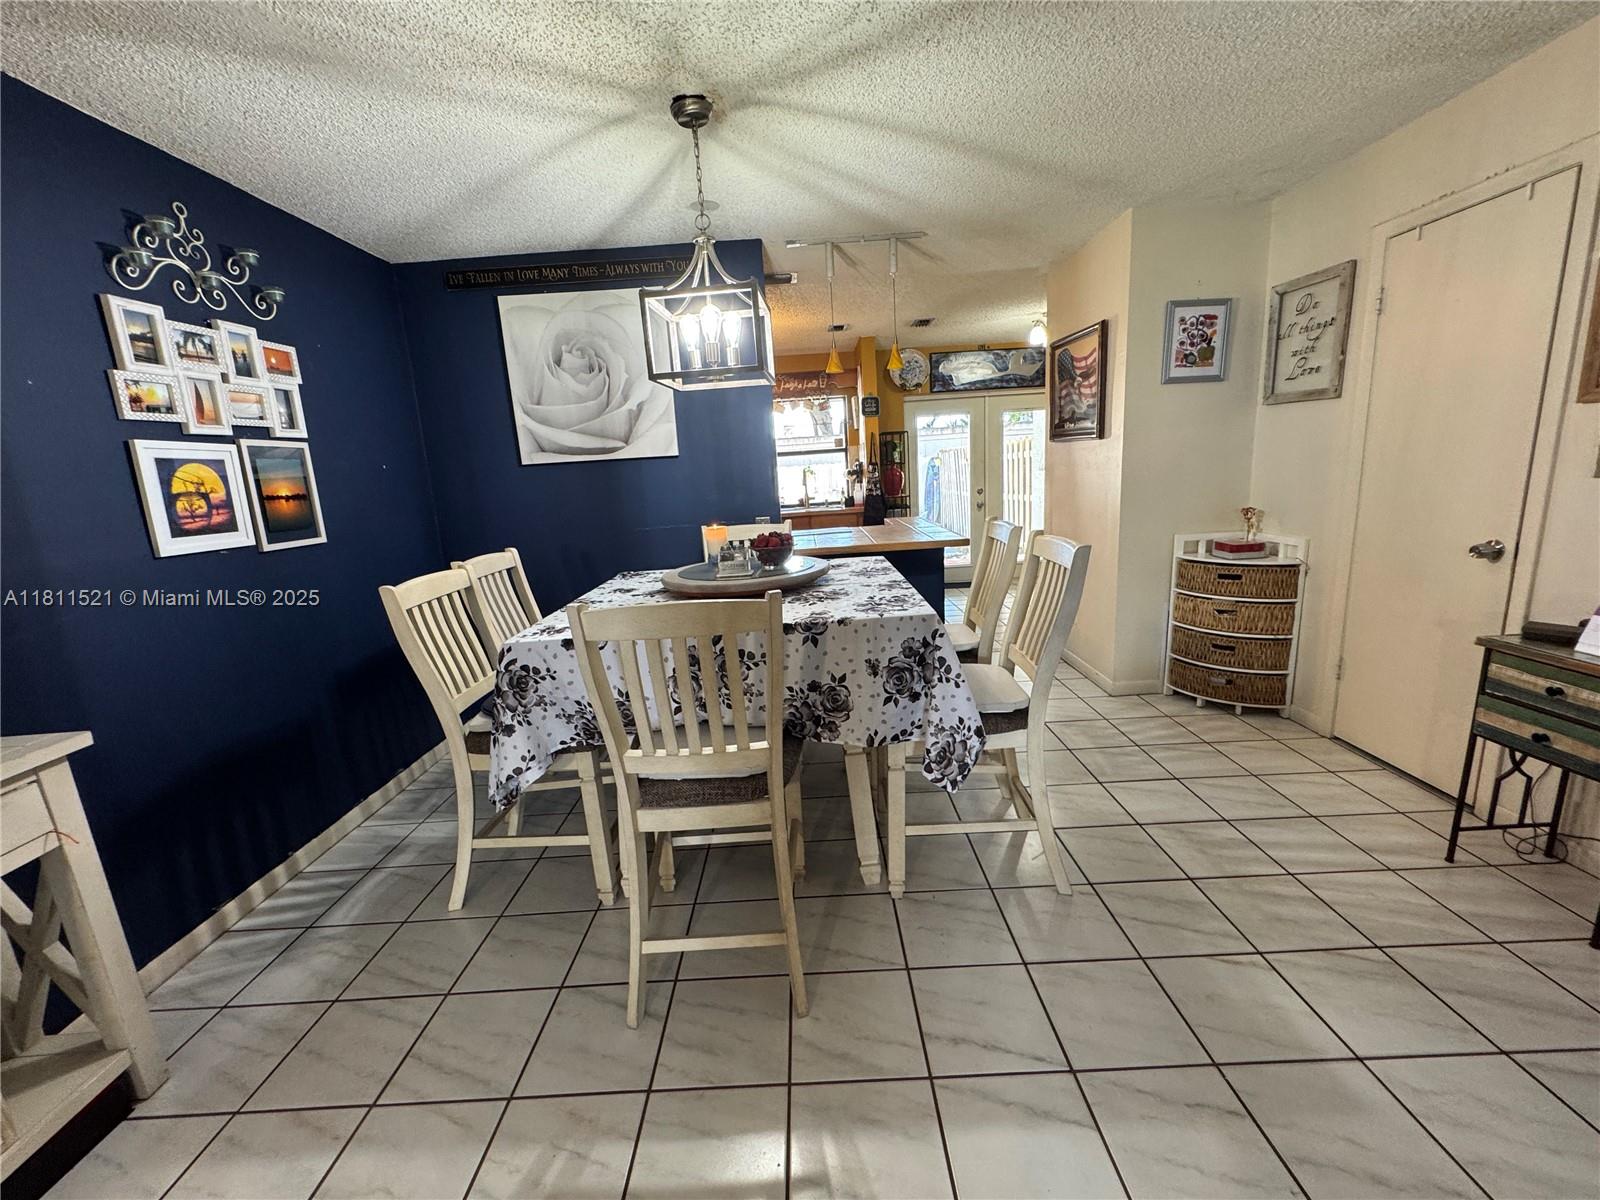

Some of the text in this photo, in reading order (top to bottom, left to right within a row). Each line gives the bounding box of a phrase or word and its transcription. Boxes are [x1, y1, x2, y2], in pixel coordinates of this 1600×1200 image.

[465, 271, 501, 284] FALLEN
[503, 270, 514, 281] IN
[517, 269, 540, 281] LOVE
[542, 267, 569, 280] MANY
[641, 261, 664, 273] WITH
[1299, 316, 1336, 342] things
[1291, 341, 1318, 358] with
[1285, 357, 1322, 382] Love
